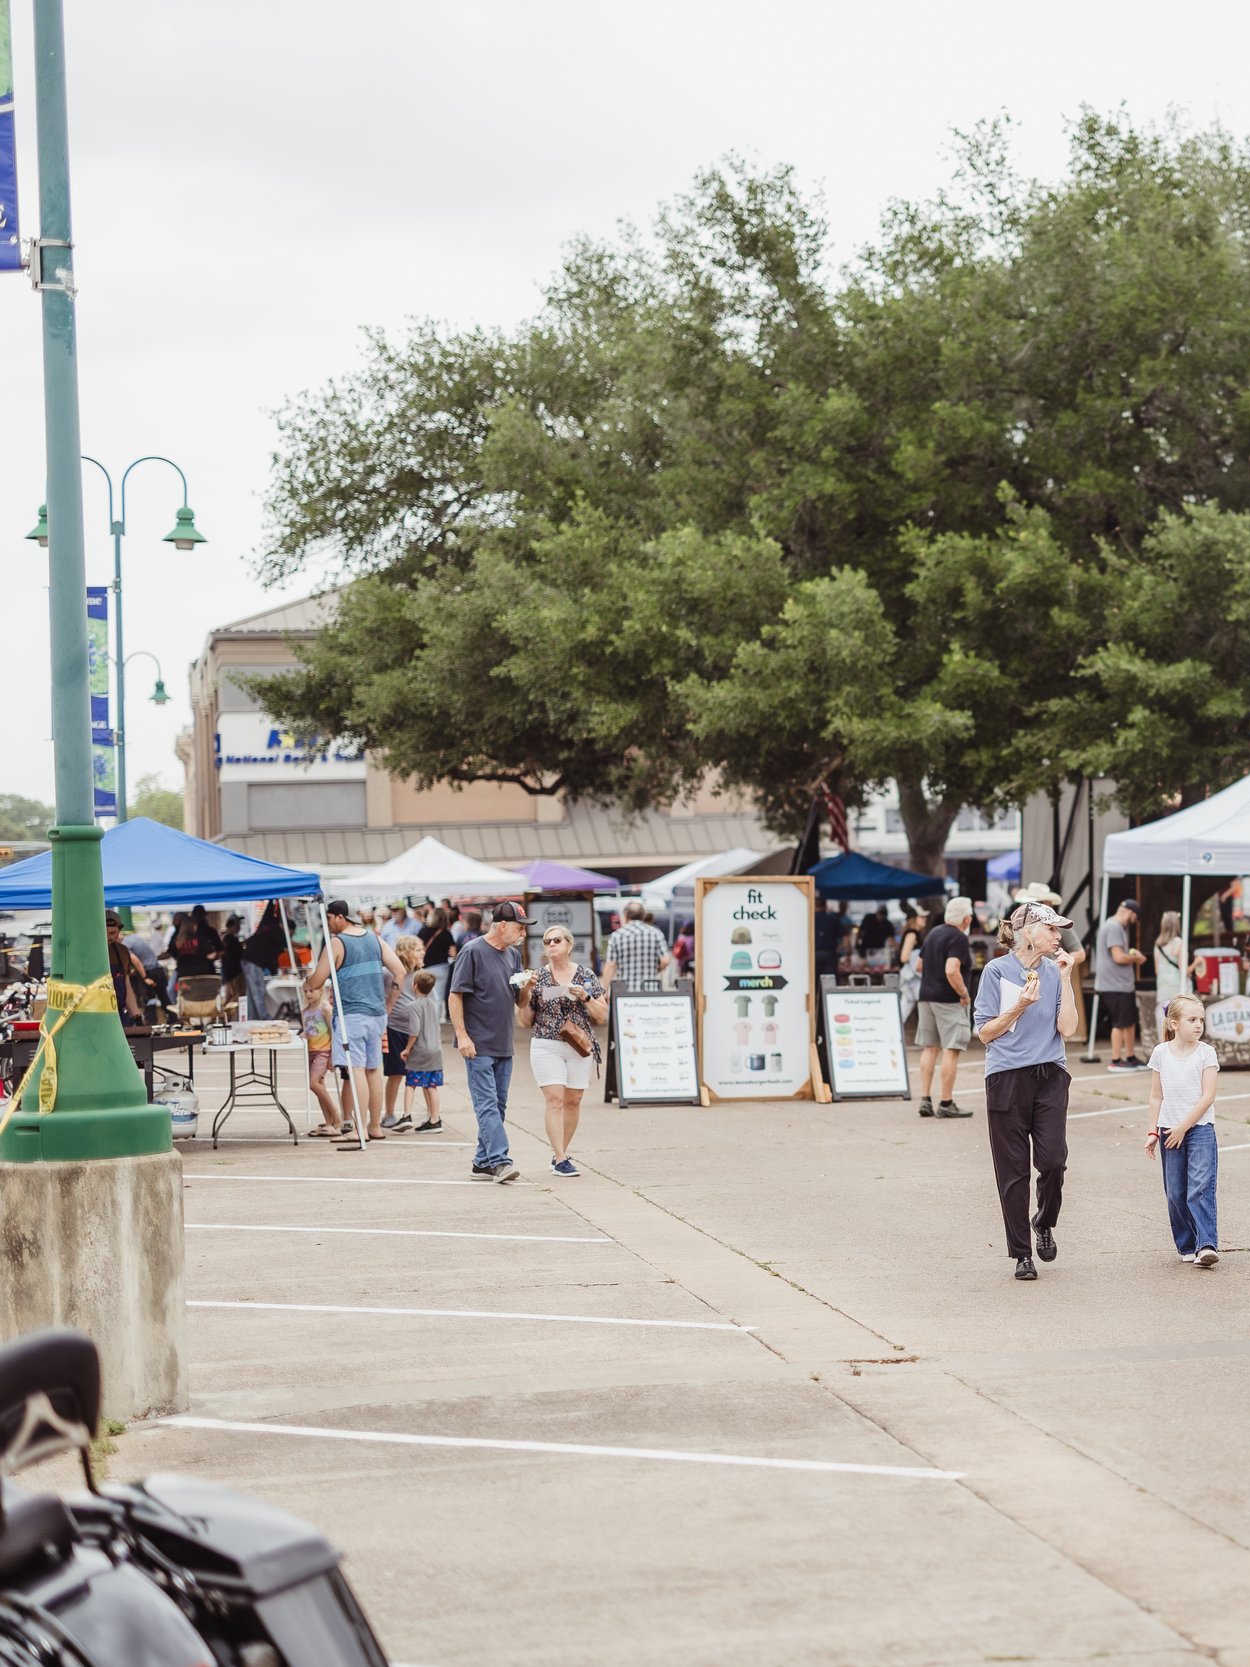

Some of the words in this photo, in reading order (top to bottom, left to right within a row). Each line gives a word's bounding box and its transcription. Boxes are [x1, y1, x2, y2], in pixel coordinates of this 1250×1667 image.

[747, 888, 763, 904] fit
[733, 905, 777, 920] check
[739, 976, 773, 988] merch
[1211, 1012, 1225, 1026] LA
